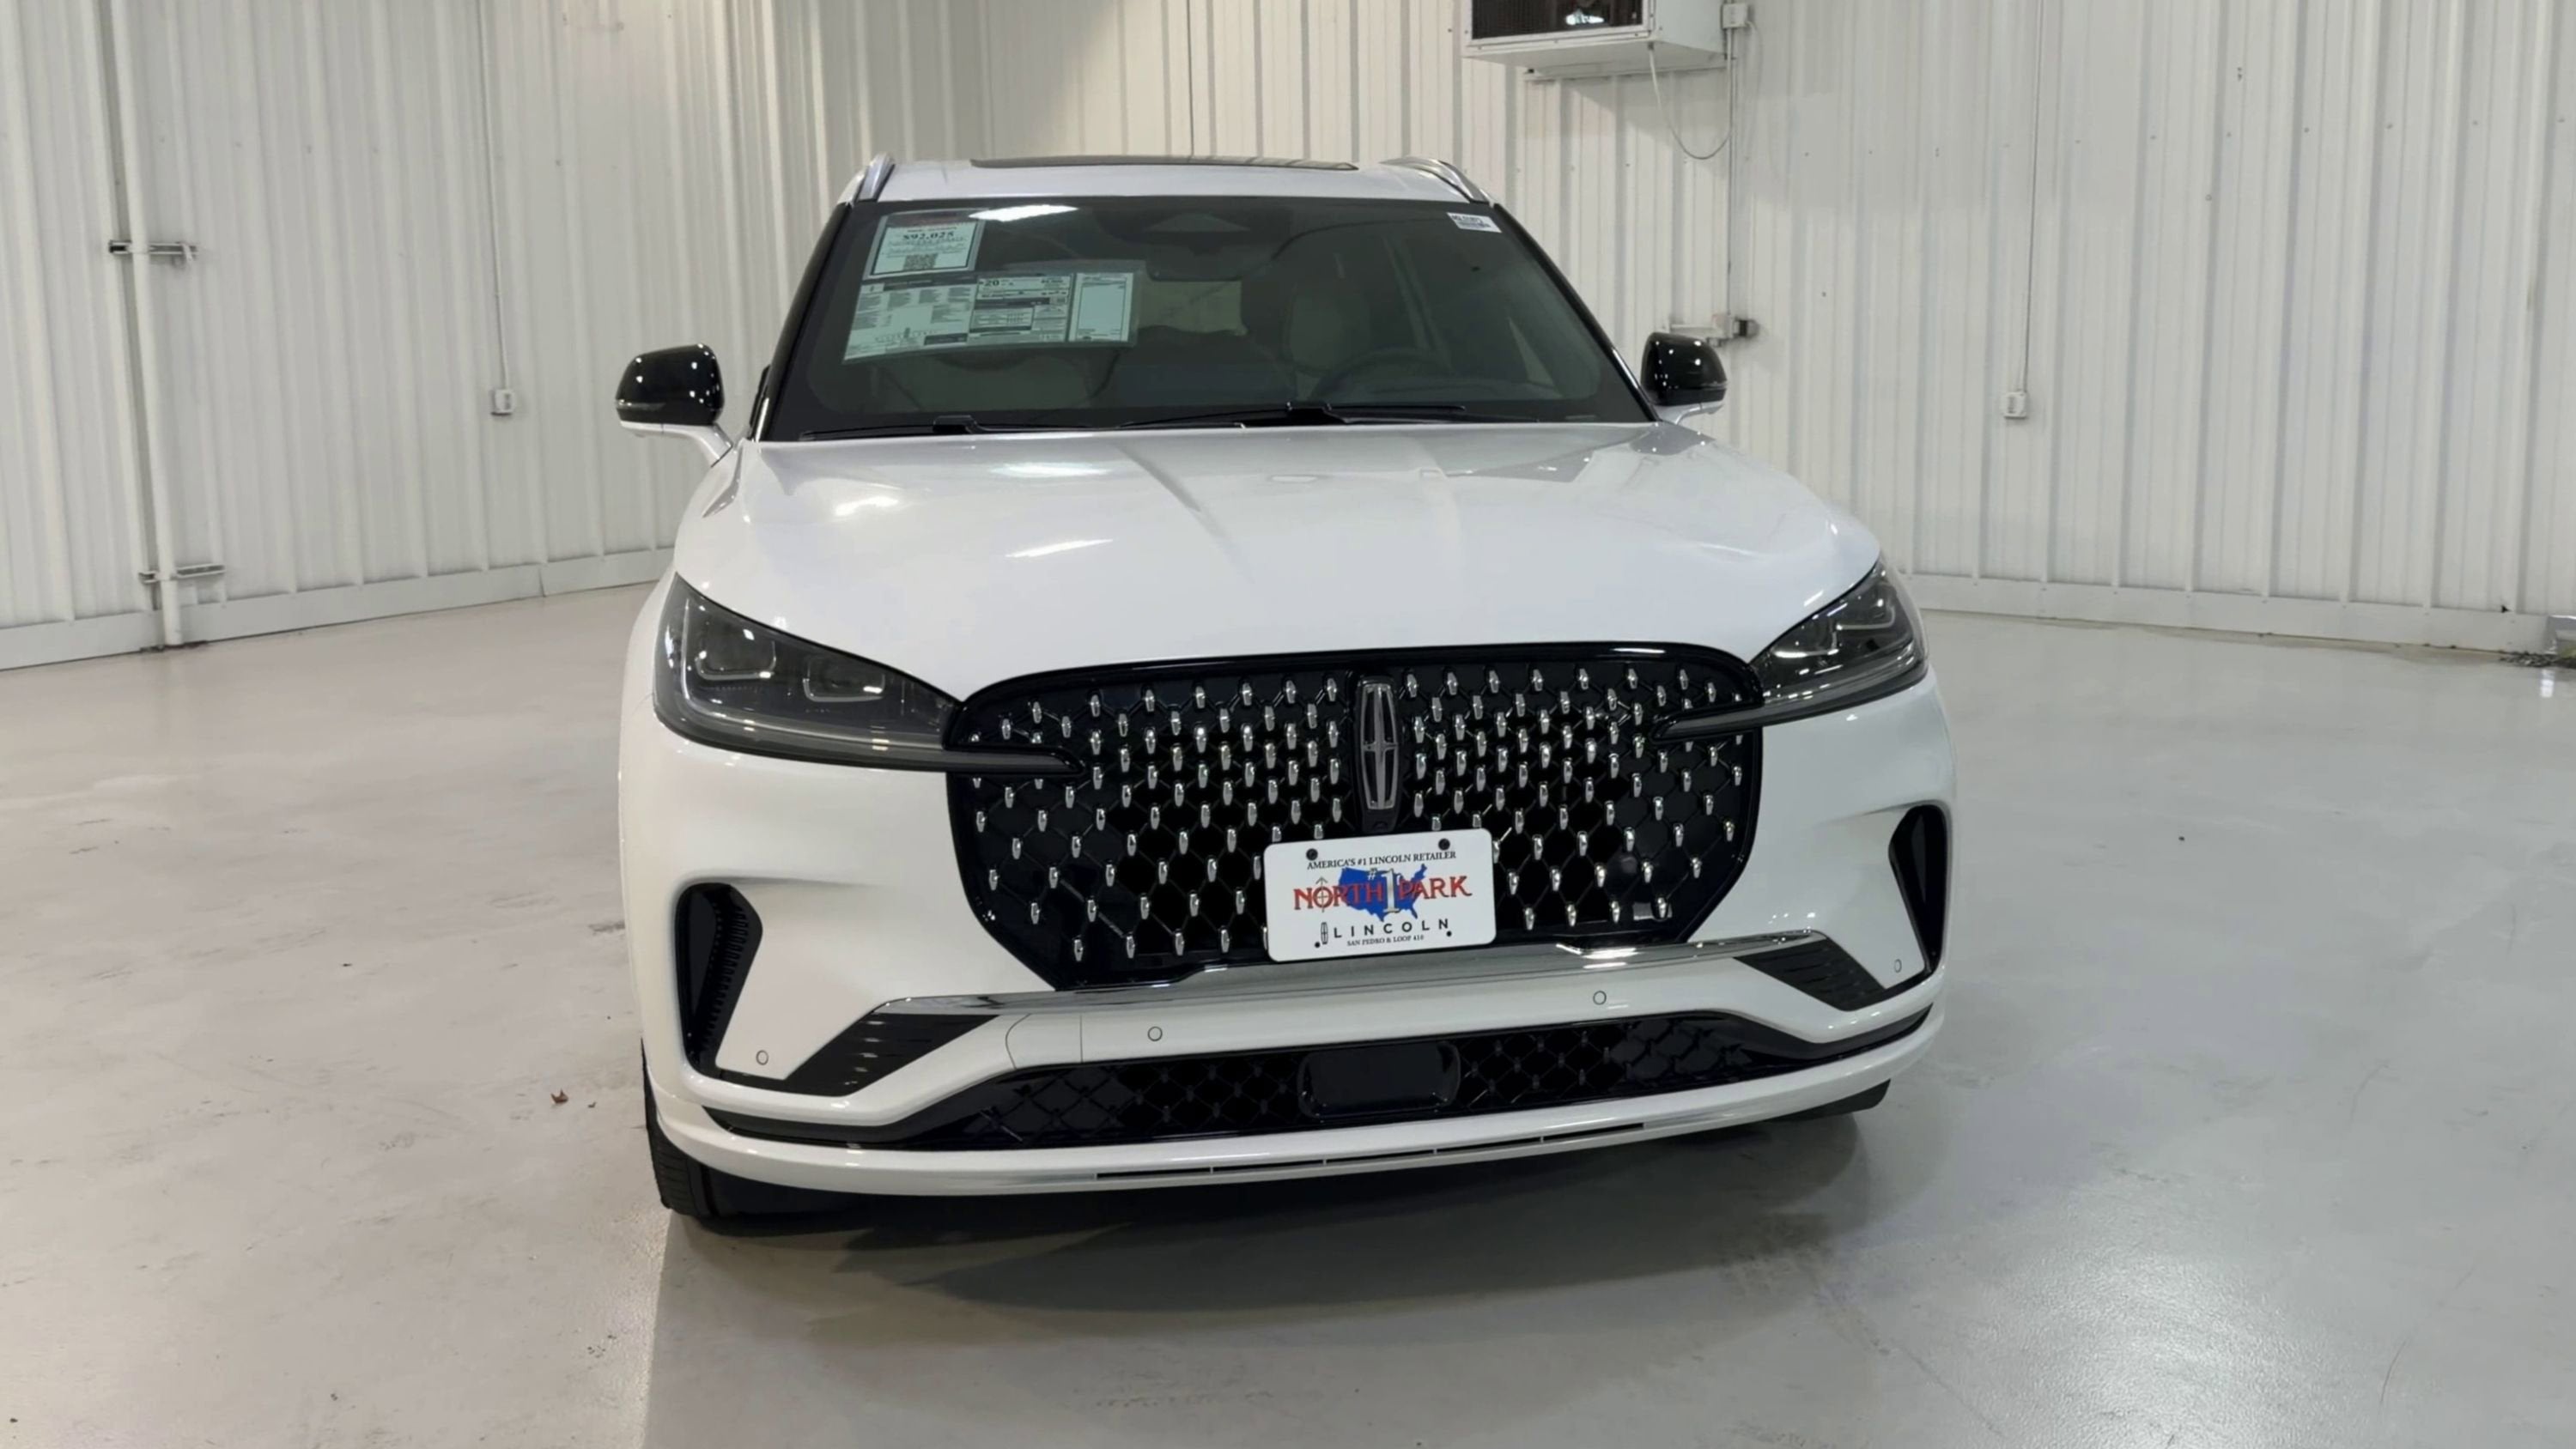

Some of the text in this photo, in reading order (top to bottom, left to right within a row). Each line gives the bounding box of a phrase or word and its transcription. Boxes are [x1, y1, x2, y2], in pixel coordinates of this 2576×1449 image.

[1307, 851, 1457, 870] AMERICA'S #1 LINCOLN RETAILER
[1293, 876, 1473, 910] NORTH PARK
[1334, 919, 1449, 937] LINCOLN
